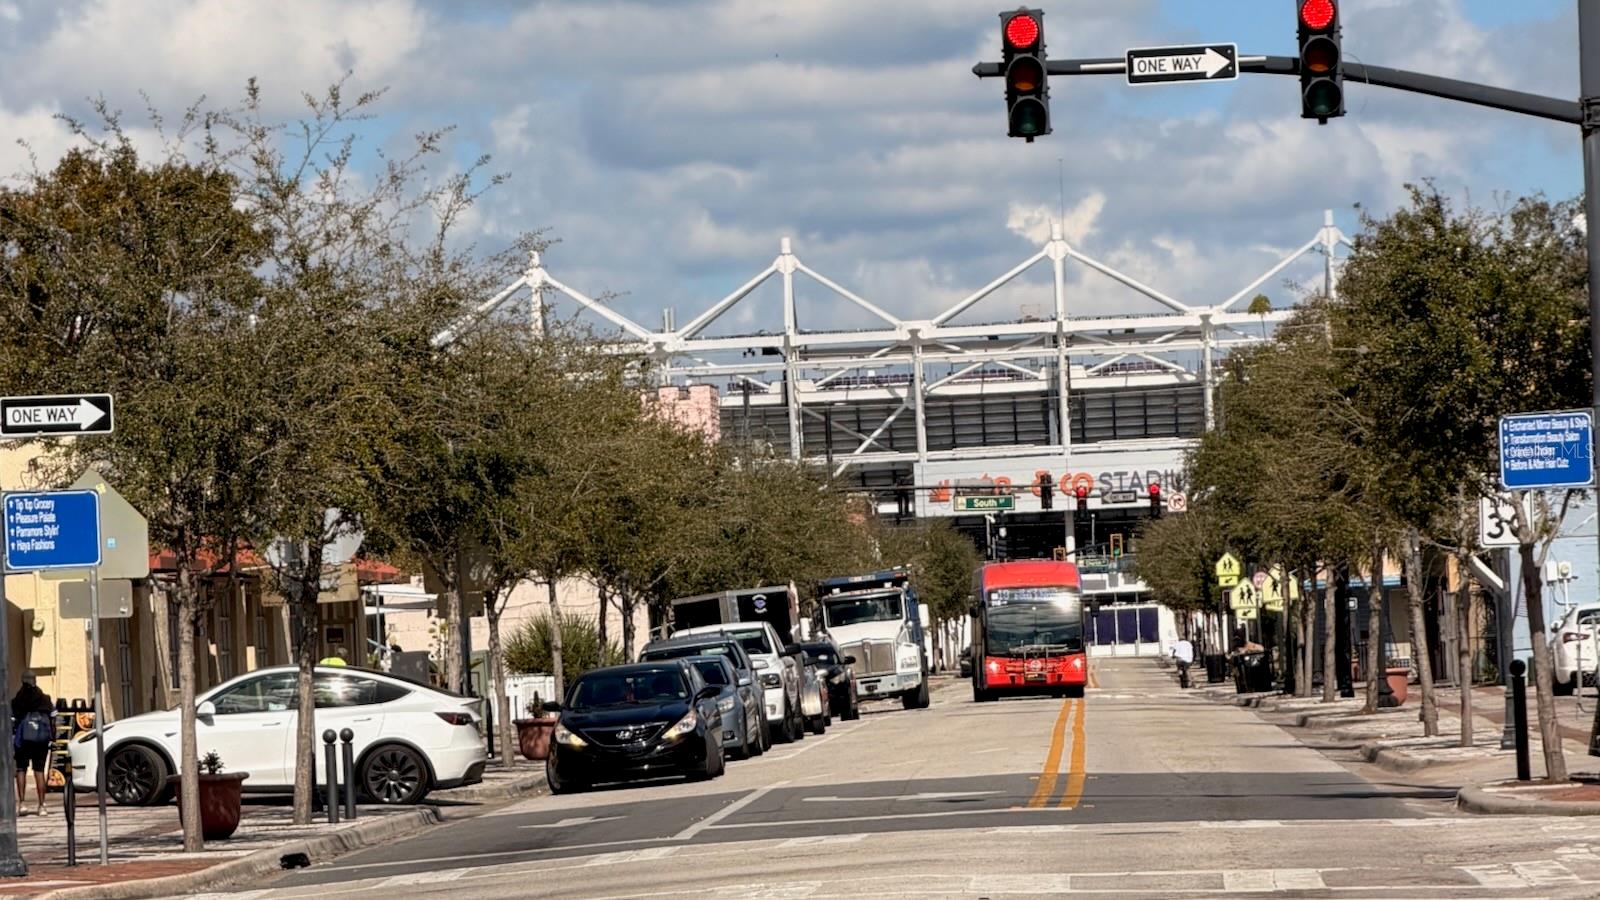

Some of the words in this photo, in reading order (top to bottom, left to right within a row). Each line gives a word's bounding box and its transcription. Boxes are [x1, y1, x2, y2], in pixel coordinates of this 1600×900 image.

[1137, 58, 1167, 73] ONE
[1172, 57, 1202, 71] WAY
[12, 408, 42, 423] ONE
[46, 407, 77, 422] WAY
[1509, 420, 1536, 431] Enchanted
[1536, 419, 1551, 430] Mirror
[1551, 418, 1569, 432] Beauty
[1569, 417, 1575, 428] &
[1509, 432, 1546, 444] Transformation
[1546, 431, 1564, 444] Beauty
[1564, 431, 1580, 442] Salon
[1510, 459, 1528, 470] Before
[1532, 458, 1545, 469] After
[15, 498, 24, 512] Tip
[24, 498, 33, 512] Top
[33, 498, 55, 512] Grocery
[973, 498, 998, 508] South
[15, 512, 39, 524] Pleasure
[31, 539, 56, 550] Fashions
